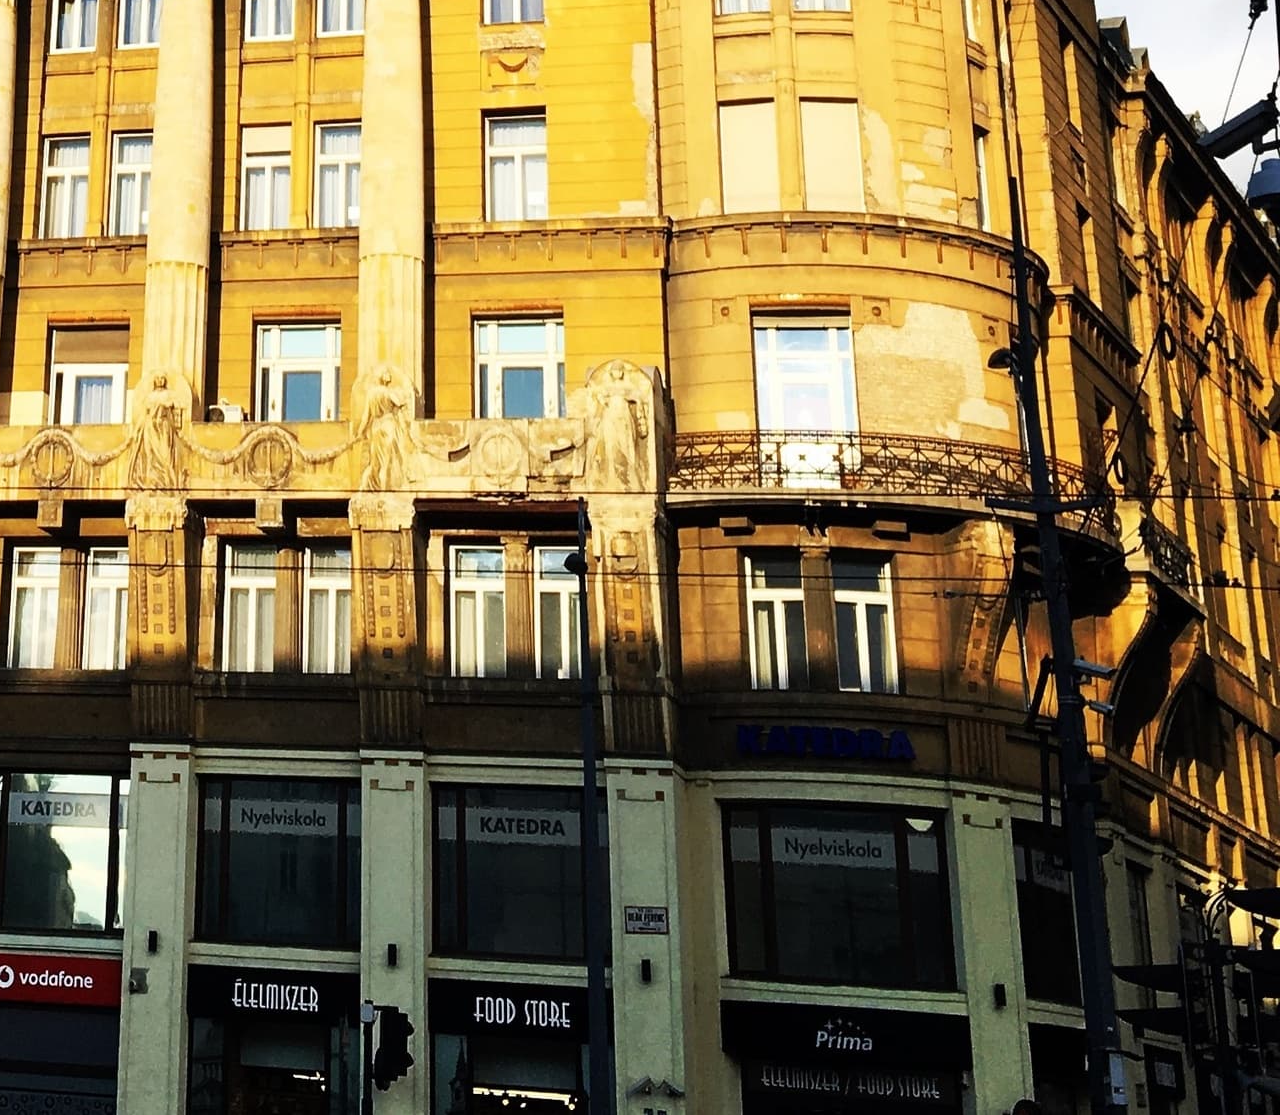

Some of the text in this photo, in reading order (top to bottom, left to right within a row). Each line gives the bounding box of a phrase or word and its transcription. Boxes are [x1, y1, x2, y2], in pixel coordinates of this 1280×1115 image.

[736, 723, 916, 761] KATEDRA
[20, 798, 98, 819] KATEDRA
[240, 806, 327, 829] Nyelviskola
[479, 815, 566, 837] KATEDRA
[783, 836, 884, 861] Nyelviskola
[19, 969, 94, 990] vodafone
[231, 978, 319, 1013] ÉLELMISZER
[473, 996, 572, 1029] FOOD STORE
[816, 1030, 873, 1052] Prima
[899, 1075, 941, 1099] STORE
